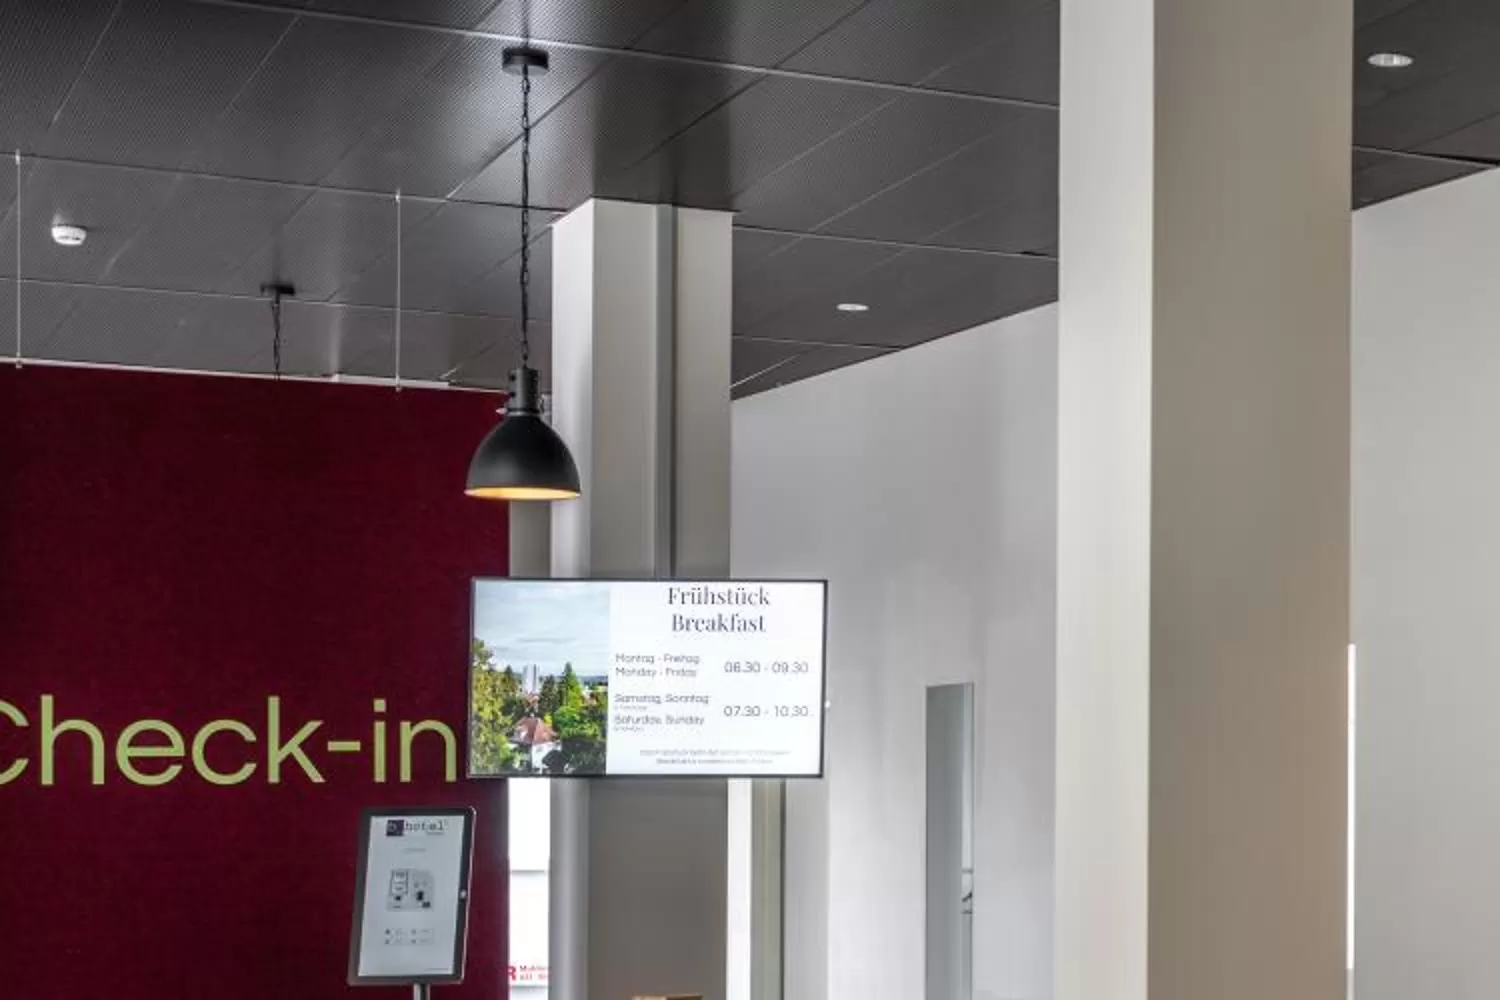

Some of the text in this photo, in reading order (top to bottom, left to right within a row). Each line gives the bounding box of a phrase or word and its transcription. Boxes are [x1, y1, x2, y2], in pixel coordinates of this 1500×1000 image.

[667, 585, 771, 605] Frühstück
[672, 613, 767, 633] Breakfast
[615, 652, 655, 664] Montag
[663, 652, 700, 664] Freitag
[615, 667, 657, 678] Monday
[665, 693, 710, 704] Sonntag
[723, 705, 761, 717] 07.30
[773, 705, 809, 717] 10.30
[665, 715, 705, 726] Sunday
